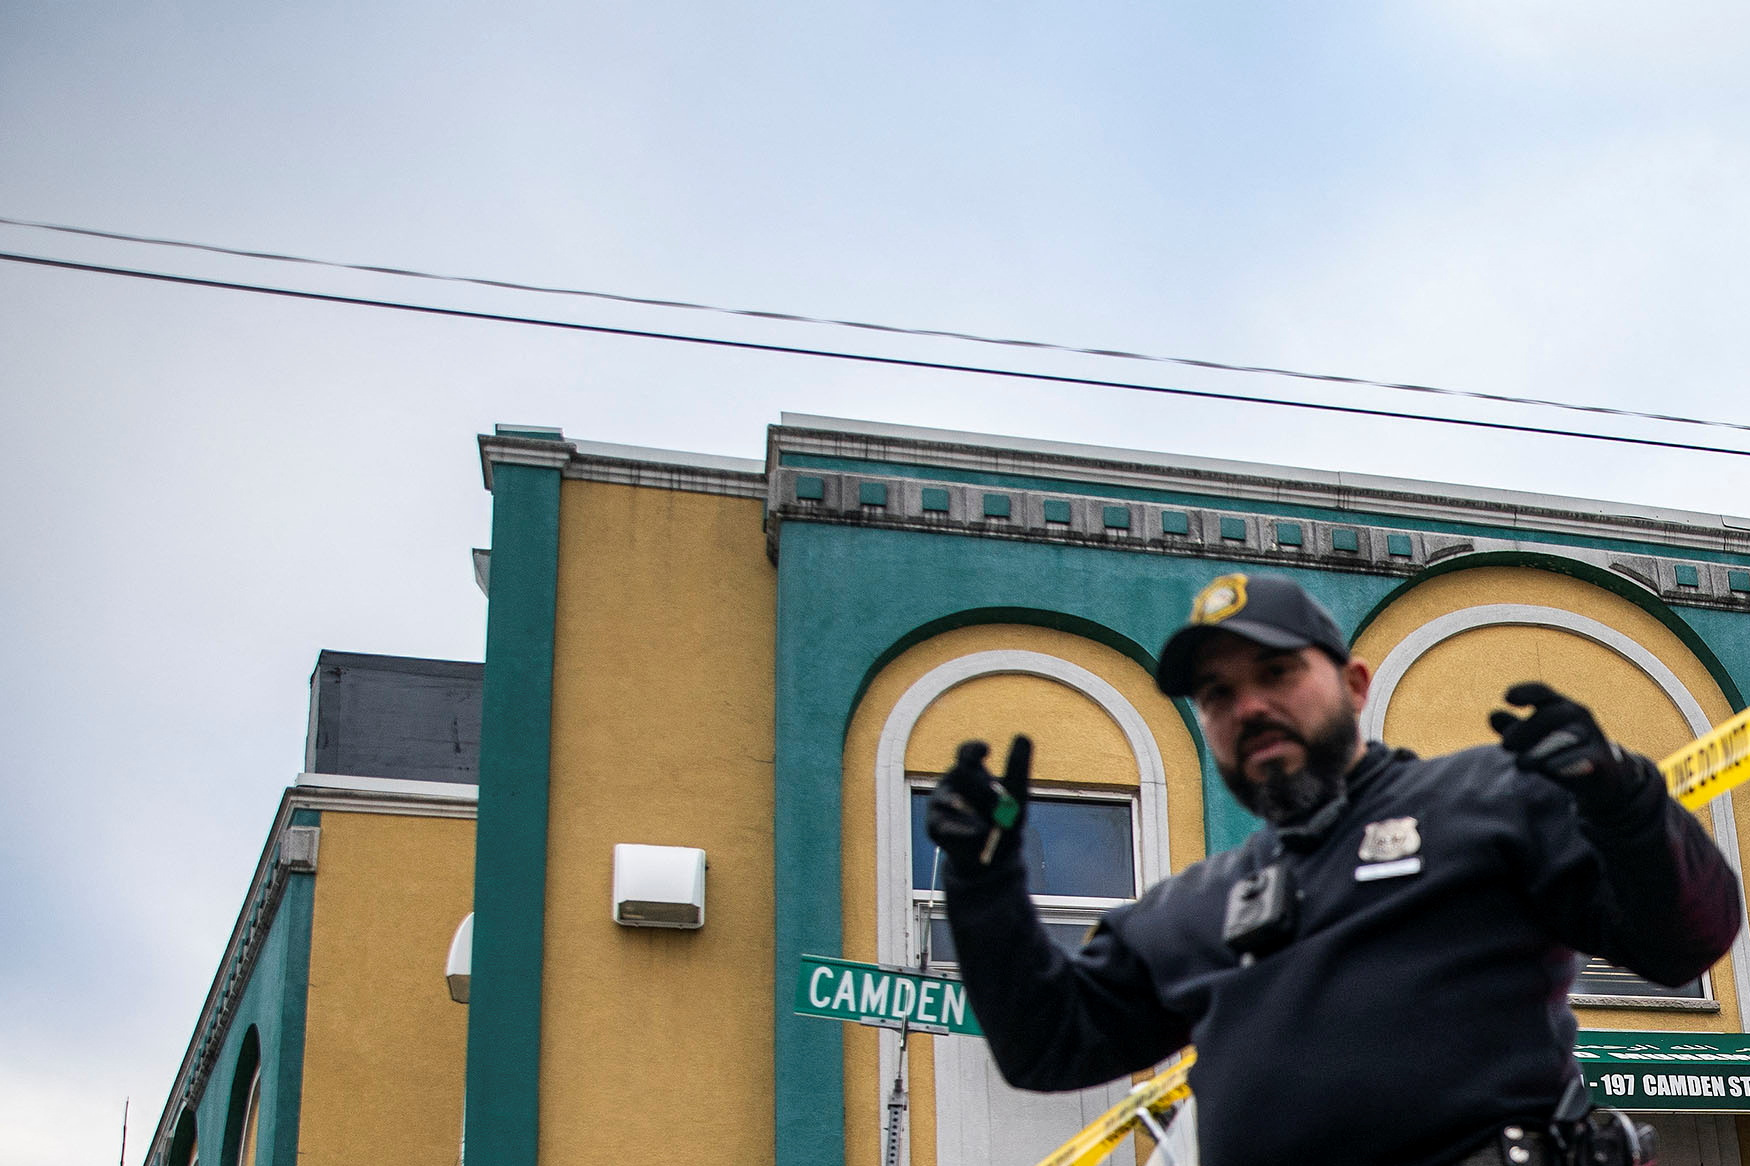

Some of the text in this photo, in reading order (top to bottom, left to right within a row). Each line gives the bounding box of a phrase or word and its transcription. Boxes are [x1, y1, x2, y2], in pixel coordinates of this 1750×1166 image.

[809, 966, 966, 1025] CAMDEN
[1600, 1073, 1635, 1096] 197
[1642, 1074, 1726, 1097] CAMDEN
